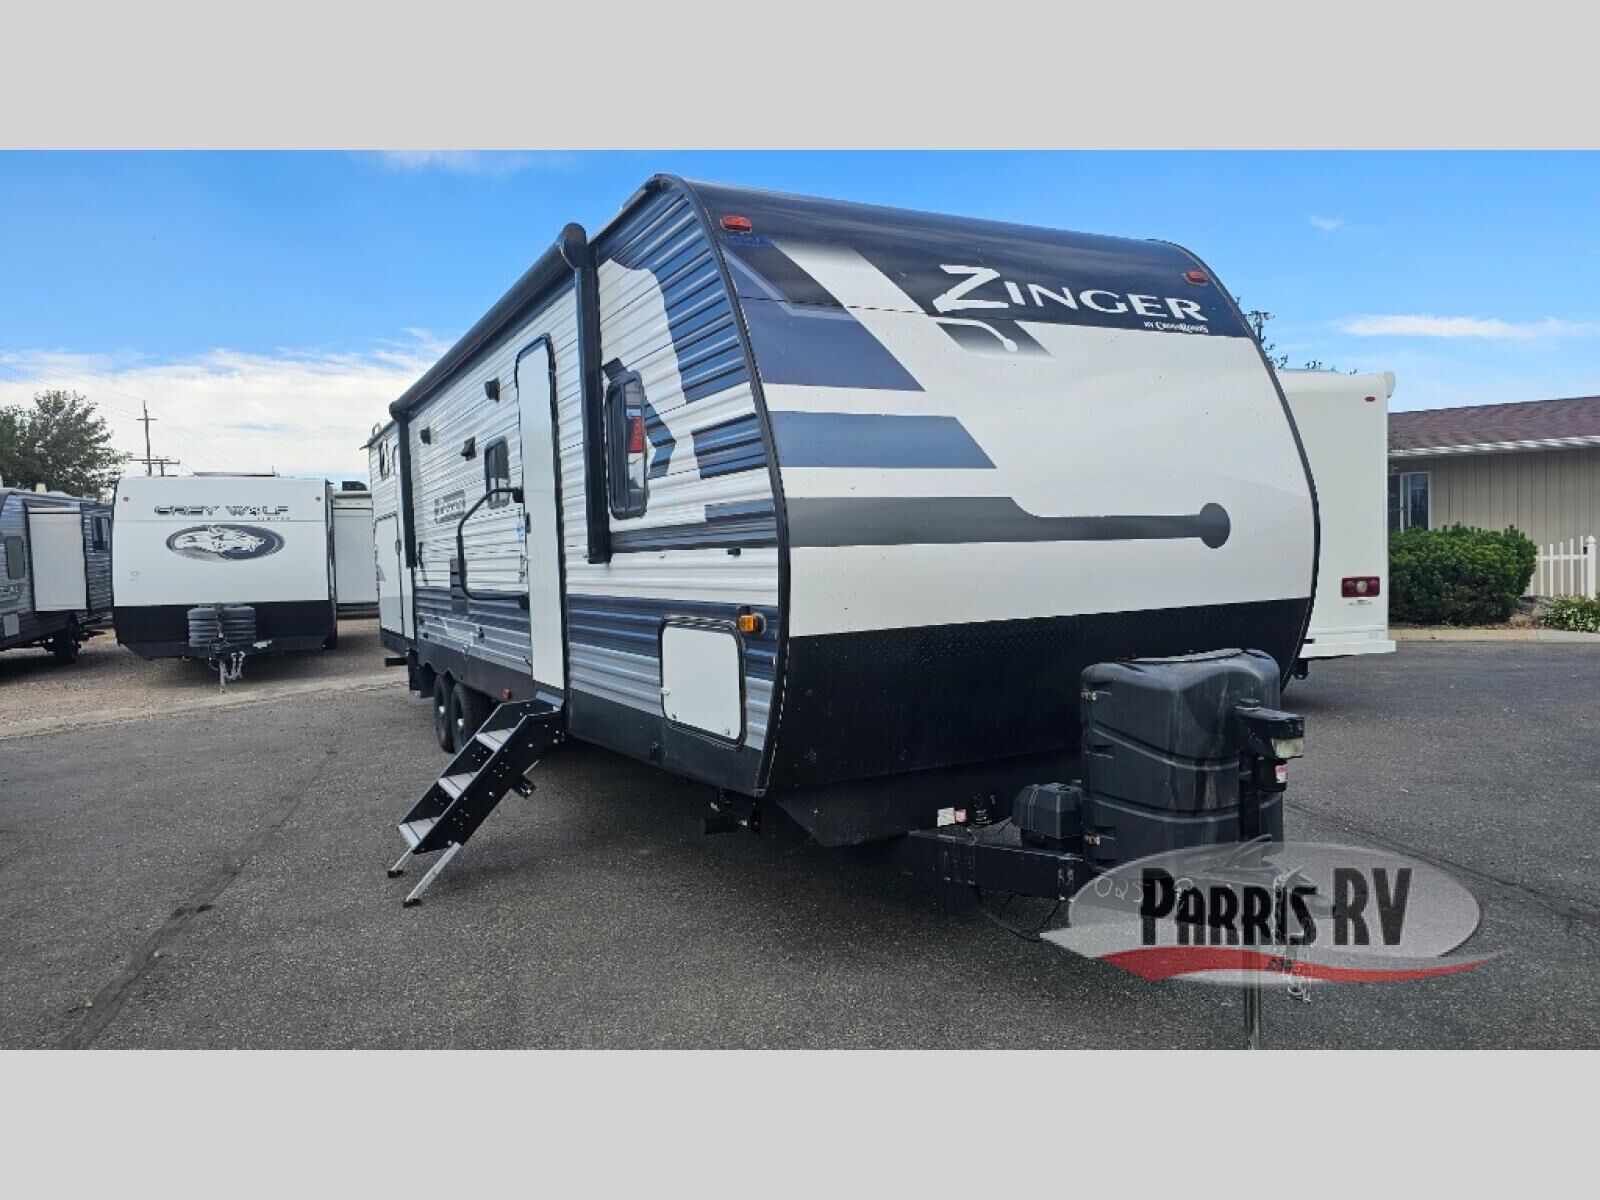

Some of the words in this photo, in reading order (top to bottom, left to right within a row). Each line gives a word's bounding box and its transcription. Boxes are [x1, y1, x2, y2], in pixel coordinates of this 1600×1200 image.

[932, 264, 1208, 321] ZINGER
[154, 505, 219, 516] GREY
[225, 505, 289, 516] WOLF
